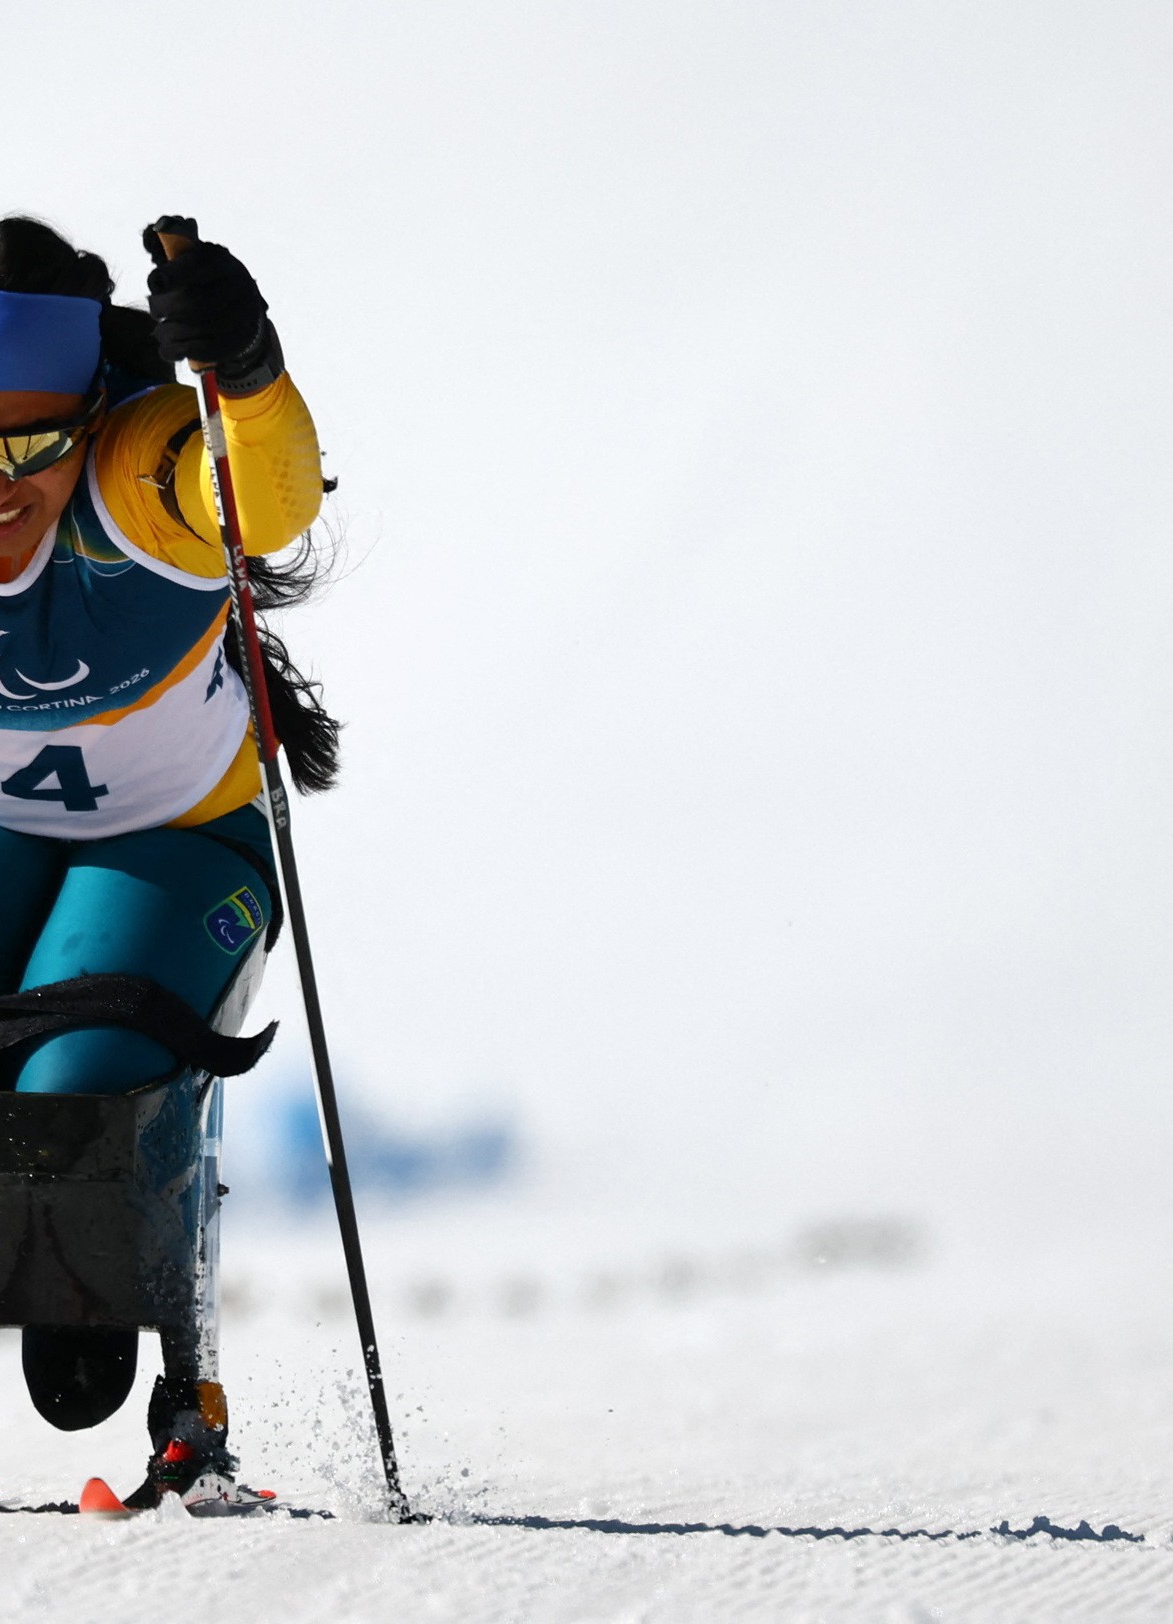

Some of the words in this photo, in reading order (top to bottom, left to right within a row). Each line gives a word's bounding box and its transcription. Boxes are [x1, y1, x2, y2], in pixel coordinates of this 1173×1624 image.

[6, 695, 104, 711] CORTINA
[110, 667, 150, 695] 2026
[1, 744, 110, 812] 4
